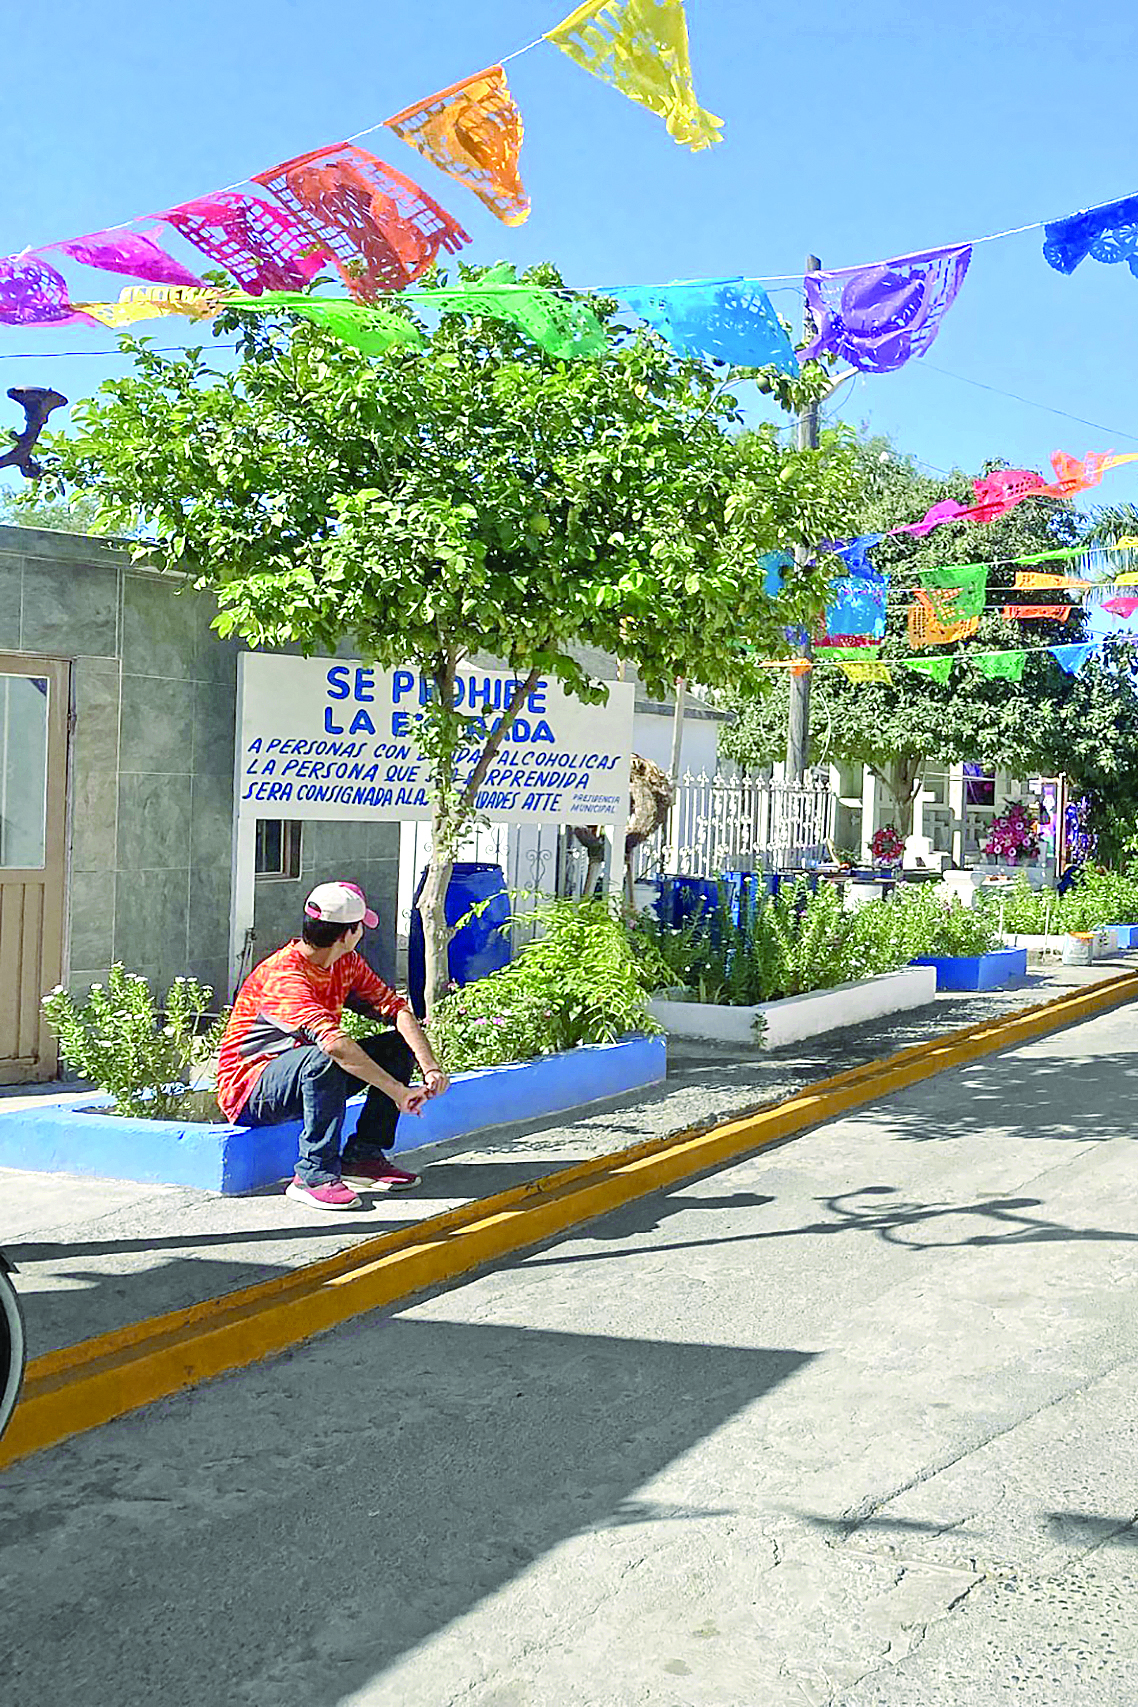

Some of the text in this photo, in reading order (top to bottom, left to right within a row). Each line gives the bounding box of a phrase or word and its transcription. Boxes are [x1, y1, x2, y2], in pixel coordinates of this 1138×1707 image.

[326, 665, 375, 702] SE
[324, 706, 376, 735] LA
[247, 737, 263, 754] A
[265, 738, 368, 758] PERSONAS
[373, 743, 412, 760] CON
[497, 750, 622, 770] ALCOHOLICAS
[246, 758, 276, 775] LA
[281, 759, 379, 782] PERSONA
[383, 764, 421, 783] QUE
[242, 782, 293, 802] SERA
[296, 784, 393, 807] CONSIGNADA
[570, 803, 616, 814] MUNICIPAL
